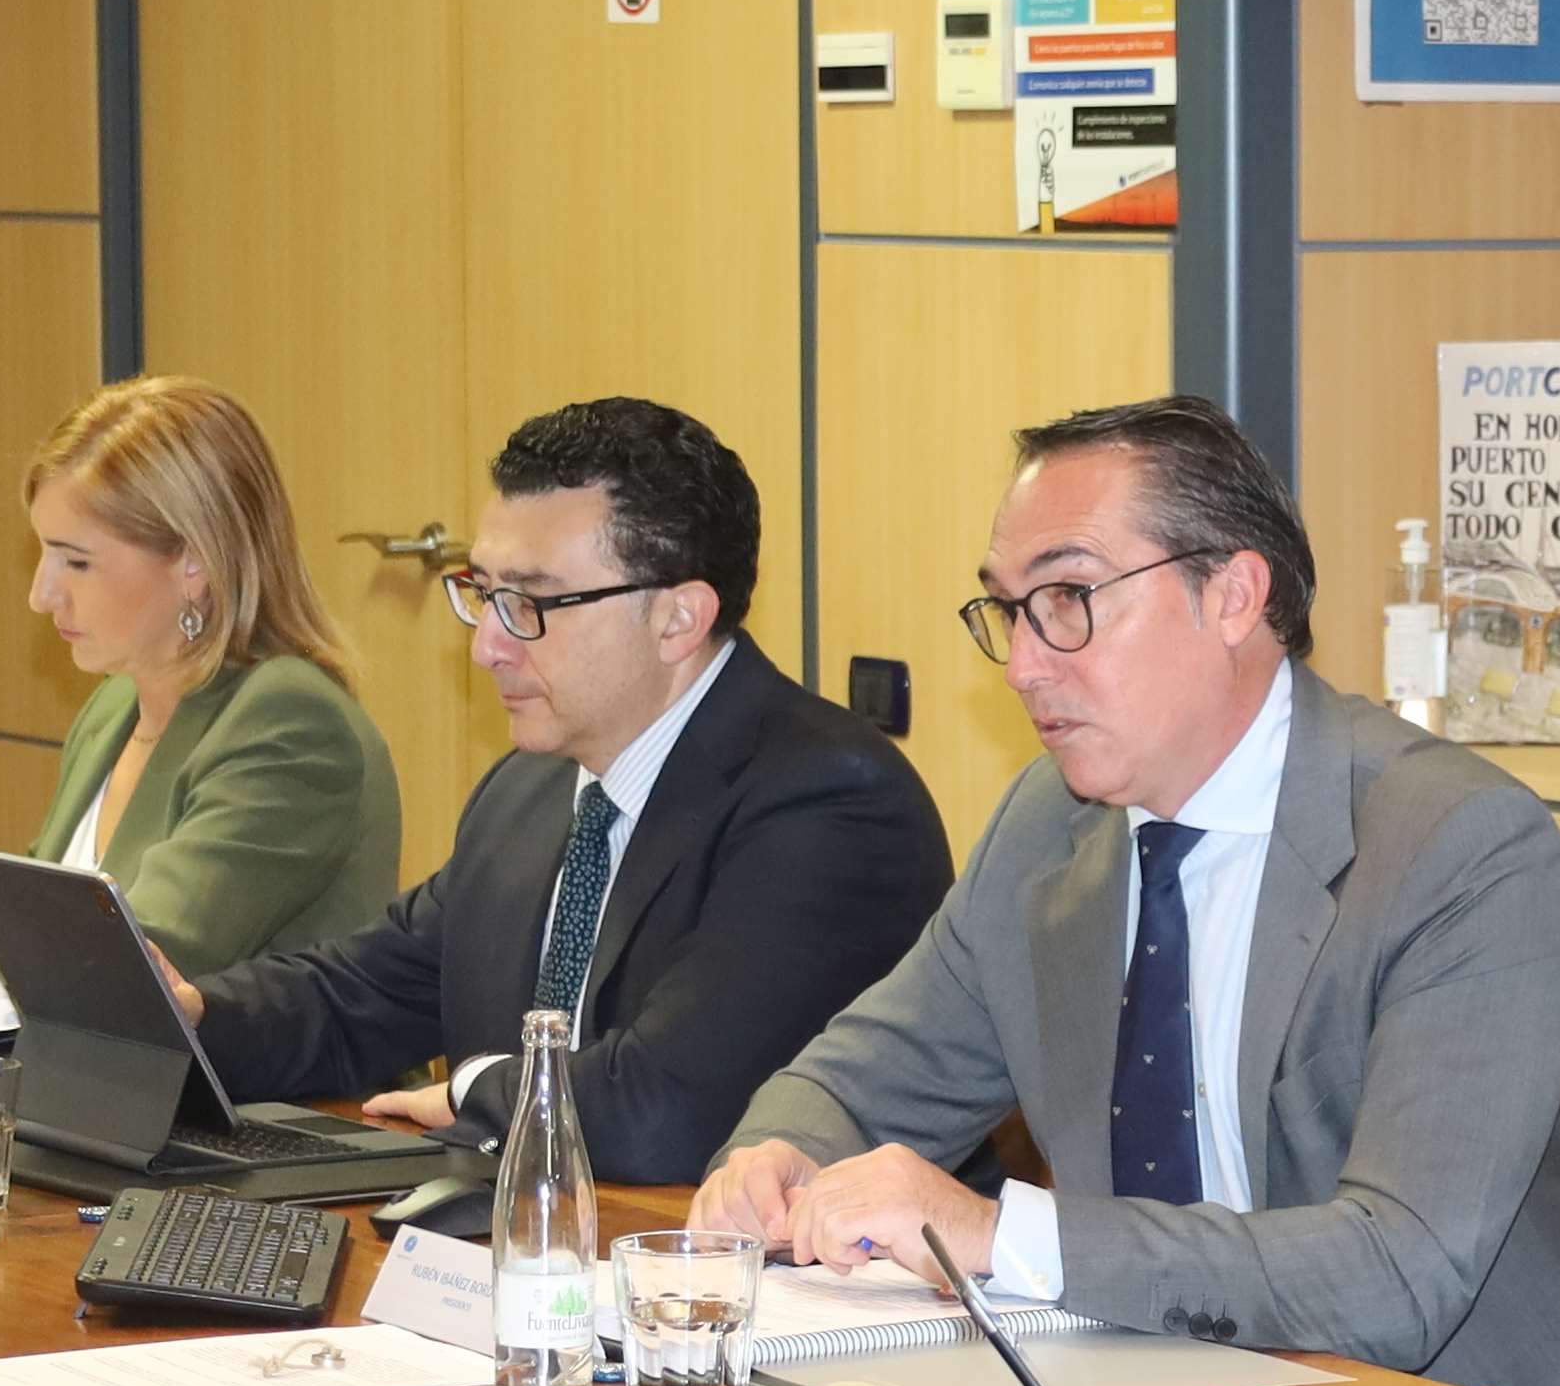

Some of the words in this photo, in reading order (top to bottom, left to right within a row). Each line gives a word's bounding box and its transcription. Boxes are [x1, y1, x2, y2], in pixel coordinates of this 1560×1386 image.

[1474, 413, 1510, 440] EN
[1450, 447, 1546, 475] PUERTO
[1448, 481, 1486, 508] SU
[1447, 514, 1521, 541] TODO
